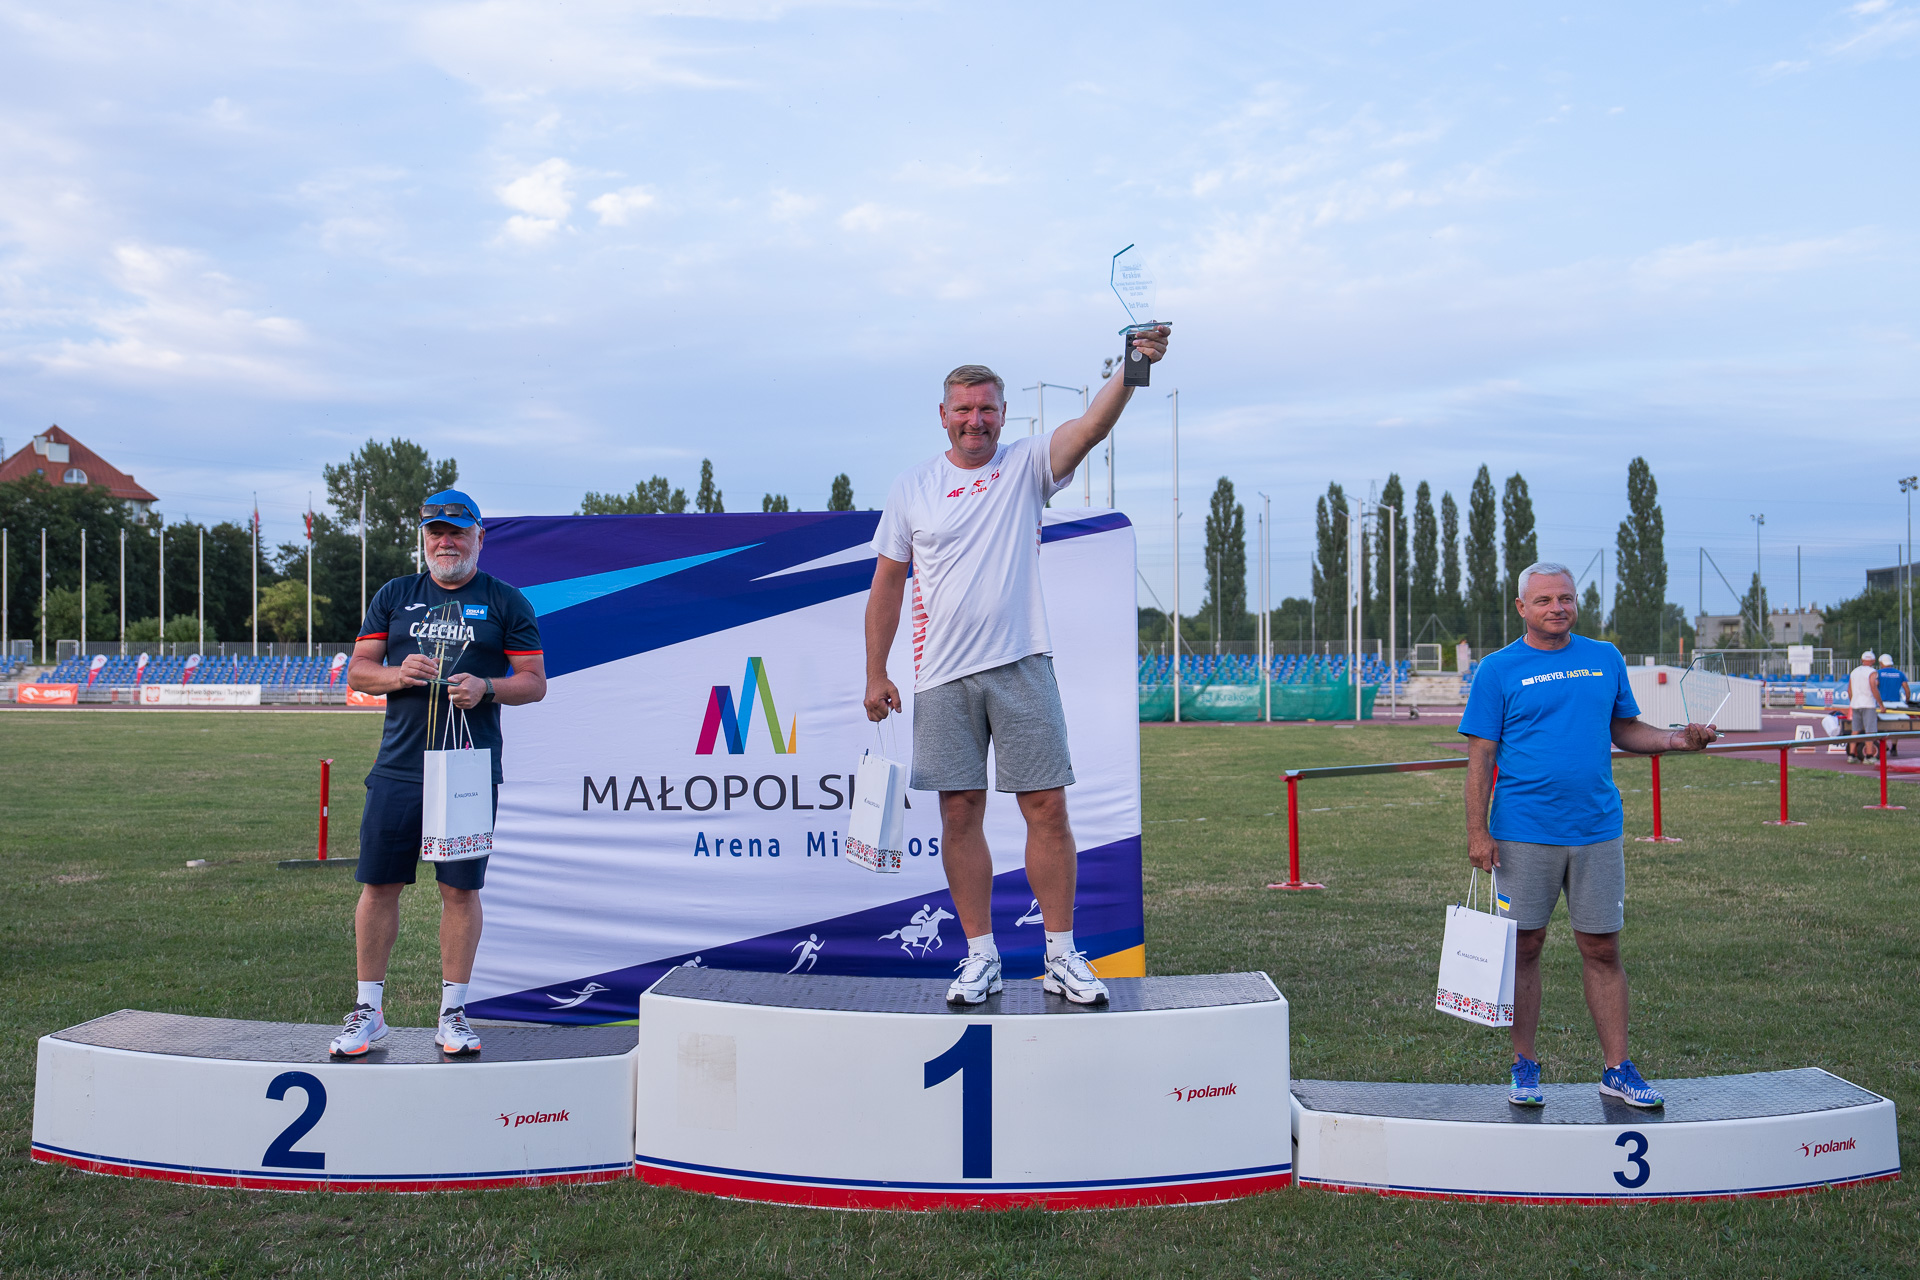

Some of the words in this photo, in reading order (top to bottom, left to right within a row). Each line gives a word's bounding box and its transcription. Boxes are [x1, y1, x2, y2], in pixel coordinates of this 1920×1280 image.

[409, 622, 475, 641] CZECHIA
[1534, 671, 1566, 682] FOREVER.
[1566, 669, 1591, 678] FASTER.
[1799, 730, 1811, 740] 70
[582, 774, 912, 812] MAŁOPOLS
[693, 831, 781, 858] Arena
[923, 1024, 993, 1179] 1
[1186, 1082, 1238, 1103] polanik
[262, 1070, 327, 1170] 2
[514, 1108, 571, 1128] polanik
[1813, 1136, 1857, 1158] polanik
[1613, 1130, 1651, 1189] 3
